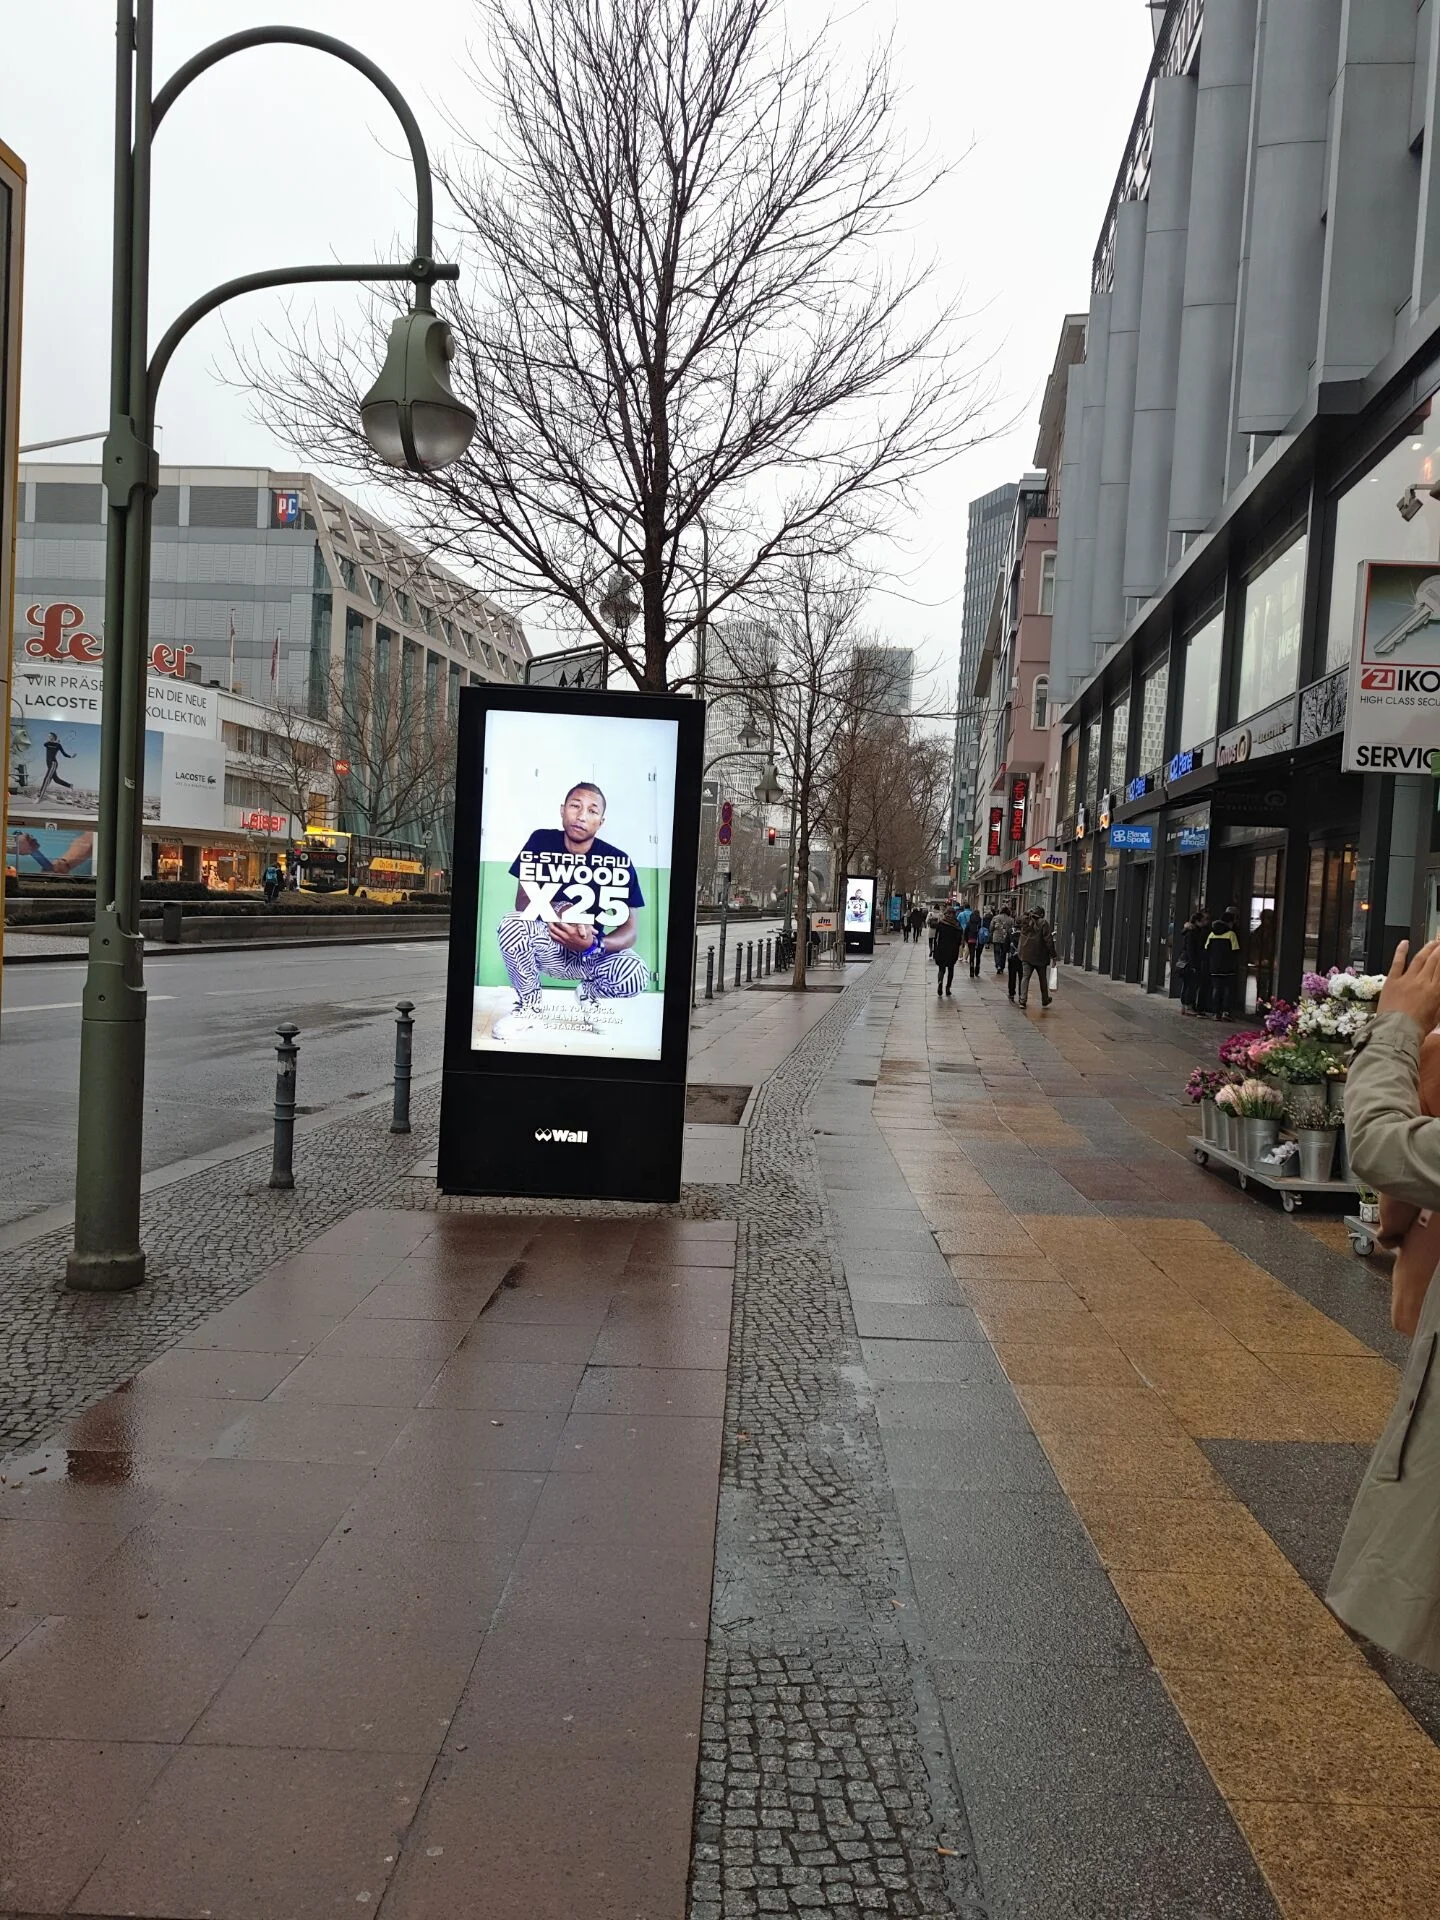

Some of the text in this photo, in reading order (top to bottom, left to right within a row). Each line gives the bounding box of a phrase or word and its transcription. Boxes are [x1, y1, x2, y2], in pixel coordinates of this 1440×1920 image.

[25, 602, 194, 678] Leer
[28, 674, 56, 687] WIR
[167, 690, 183, 703] DIE
[185, 694, 207, 709] NEUE
[1360, 695, 1383, 705] HIGH
[1385, 696, 1415, 706] CLASS
[25, 694, 207, 727] LACOSTE KOLLEKTION
[175, 771, 206, 783] LACOSTE
[1126, 836, 1151, 844] Sports
[1127, 830, 1149, 838] Planet
[520, 851, 631, 868] G-STAR RAW
[1045, 854, 1063, 865] dm
[520, 862, 630, 886] ELWOOD
[519, 880, 630, 927] X25
[552, 1129, 589, 1143] Wall
